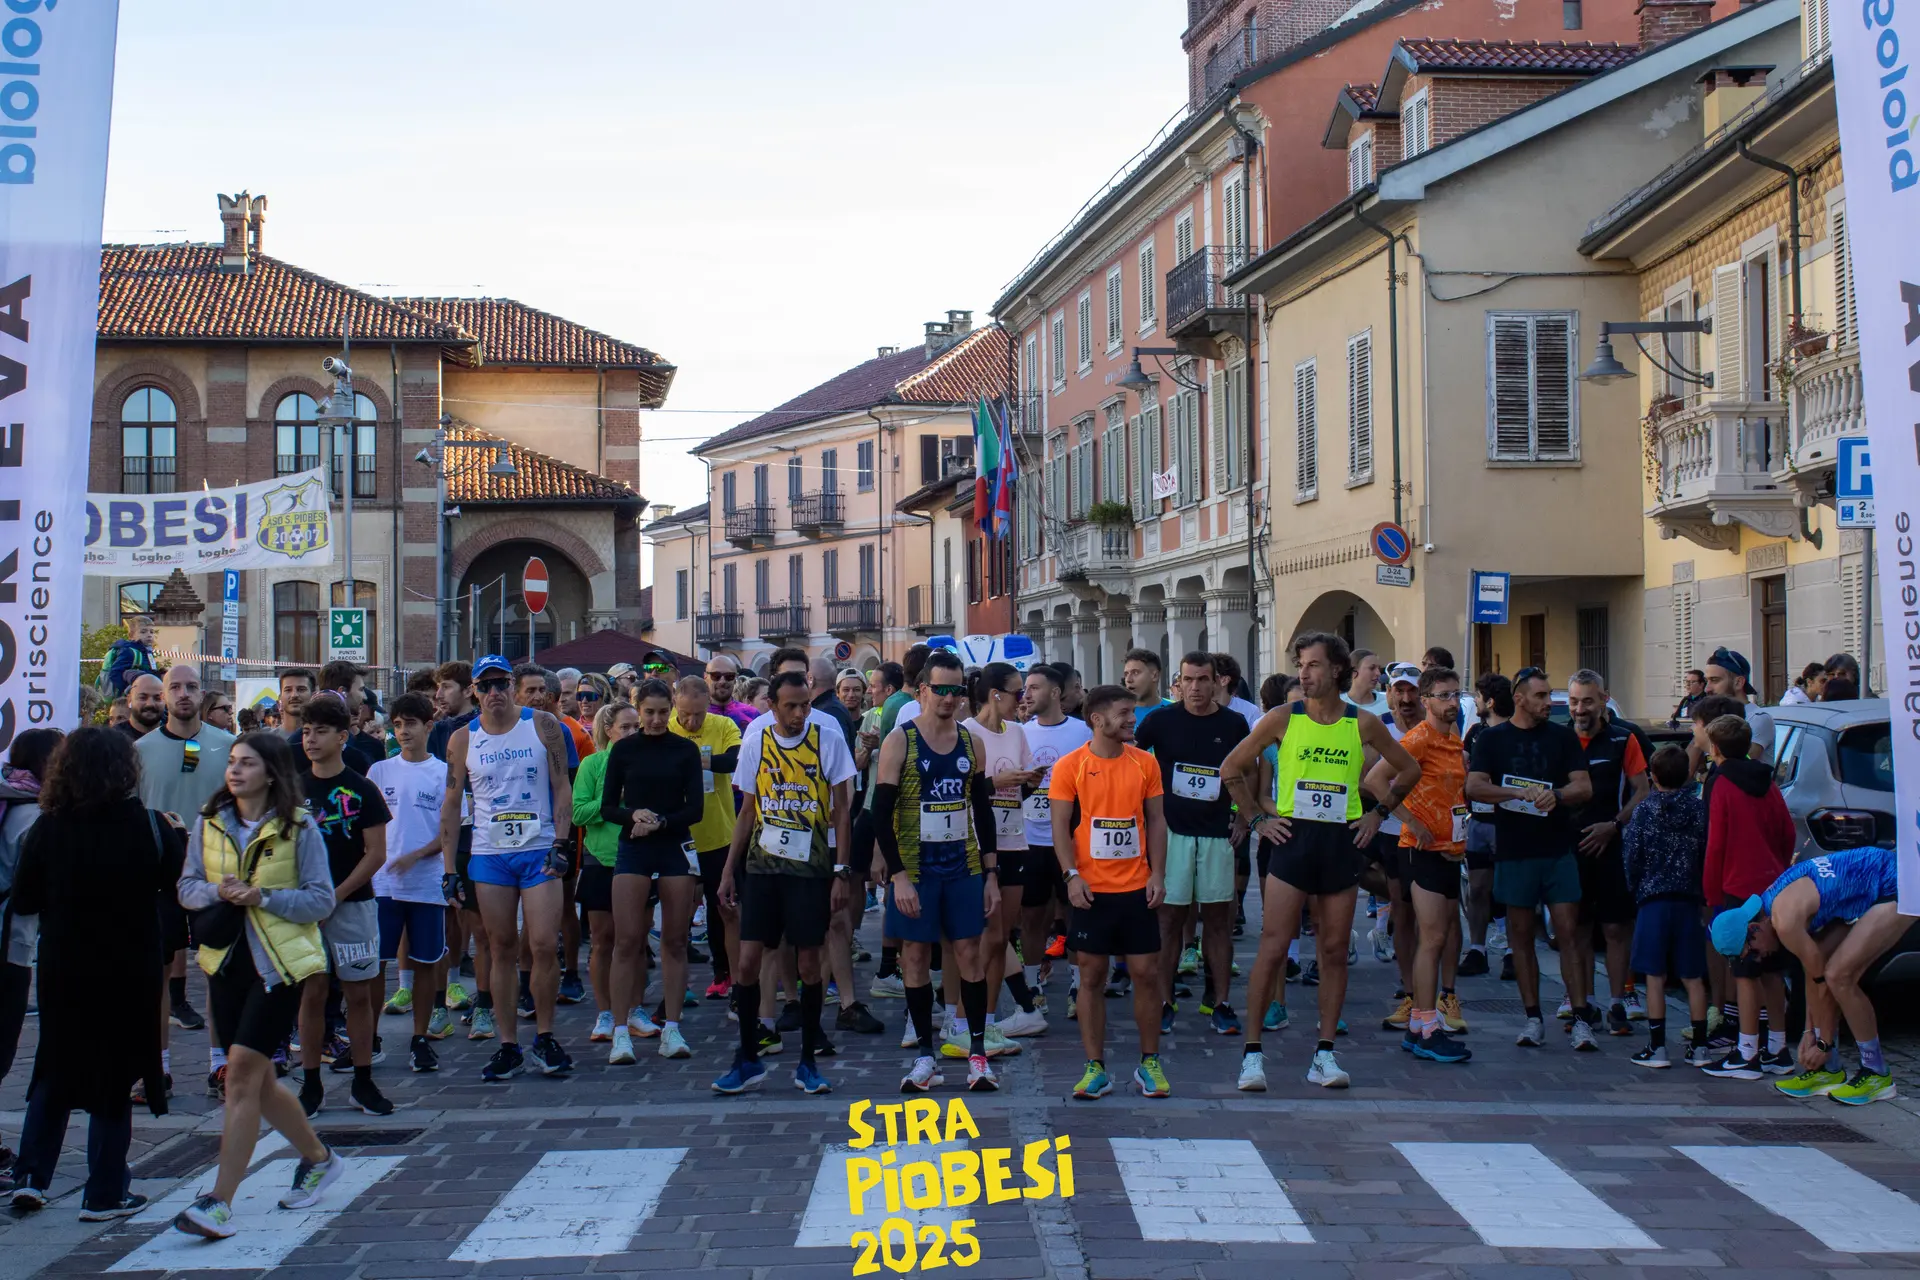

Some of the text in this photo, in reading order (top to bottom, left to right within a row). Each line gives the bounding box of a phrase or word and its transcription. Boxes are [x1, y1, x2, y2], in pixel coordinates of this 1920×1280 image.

[226, 572, 237, 598] P
[1313, 747, 1350, 757] RUN
[1325, 757, 1349, 766] team
[1187, 776, 1206, 789] 49
[761, 794, 818, 813] Bairese
[1033, 797, 1050, 809] 23
[1311, 793, 1332, 808] 98
[944, 814, 951, 828] 1
[1002, 810, 1010, 823] 7
[504, 822, 523, 836] 31
[779, 831, 790, 845] 5
[1103, 830, 1133, 846] 102
